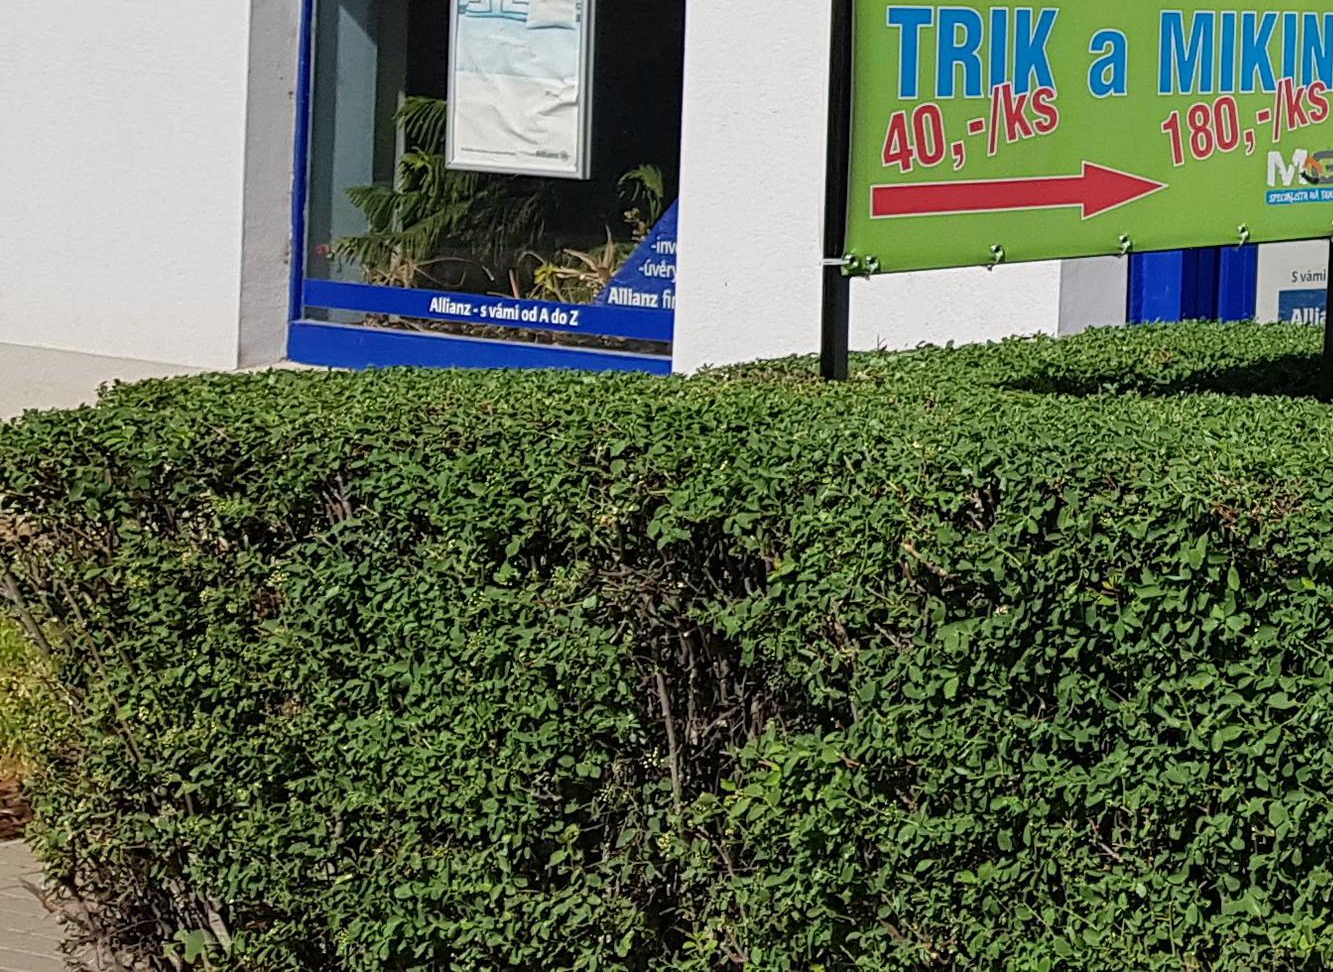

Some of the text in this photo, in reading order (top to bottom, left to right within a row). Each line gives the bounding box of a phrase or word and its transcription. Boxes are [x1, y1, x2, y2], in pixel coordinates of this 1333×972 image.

[887, 6, 1059, 100] TRIK
[1087, 28, 1127, 98] a
[882, 77, 1330, 173] 40,-/ks 180,-/ks
[1292, 271, 1298, 283] S
[1301, 269, 1327, 282] vámi
[429, 296, 470, 316] Allianz
[480, 306, 487, 317] s
[489, 302, 518, 320] vámi
[521, 305, 537, 322] od
[539, 308, 549, 324] A
[551, 309, 567, 325] do
[569, 310, 579, 326] Z
[608, 287, 659, 308] Allianz
